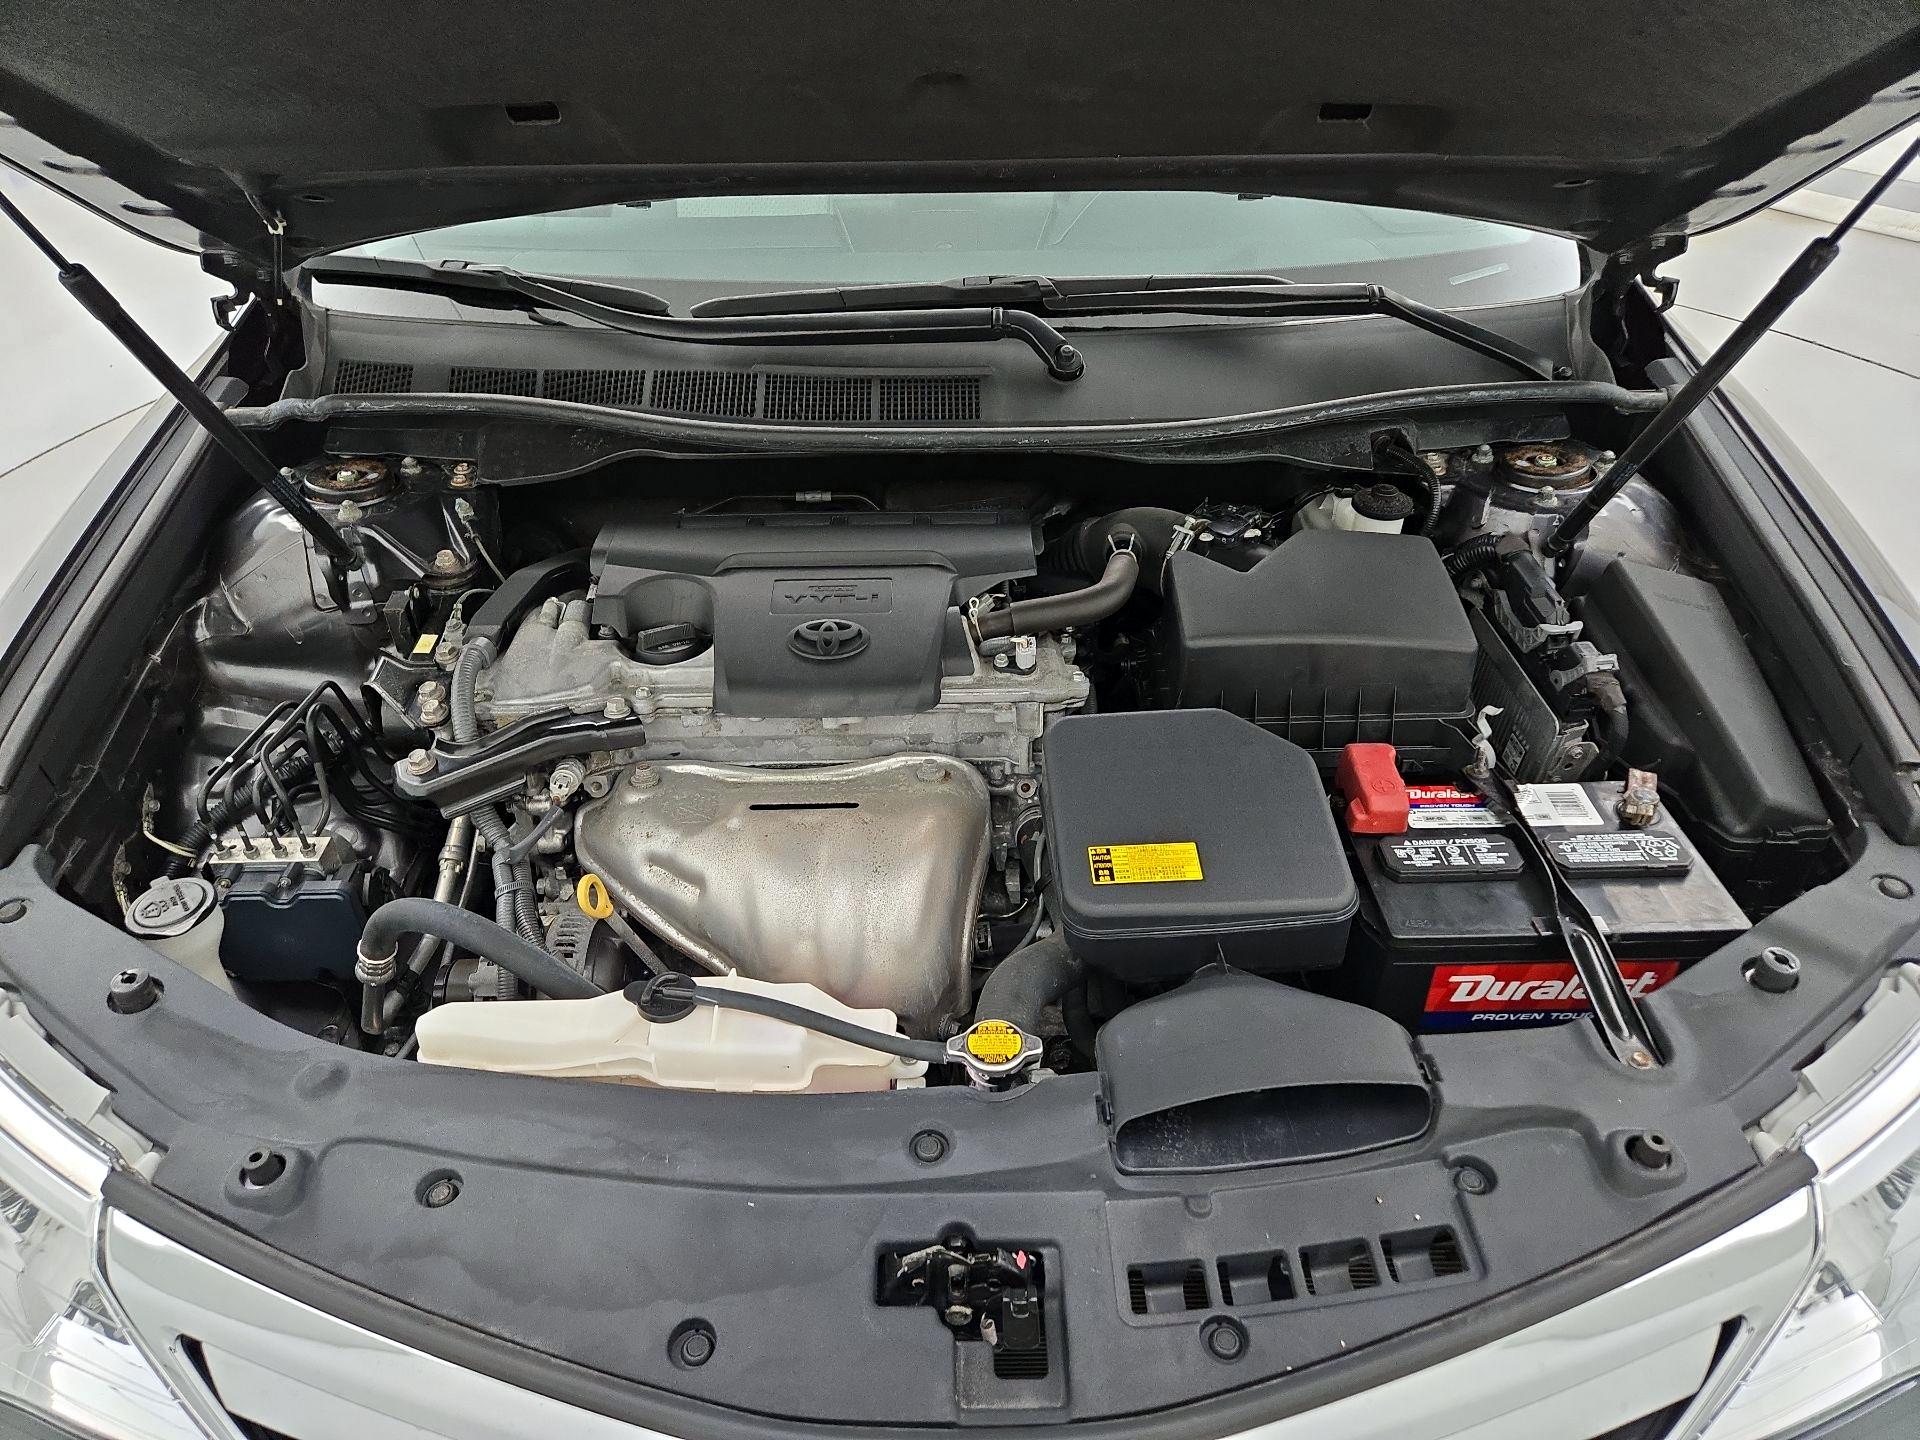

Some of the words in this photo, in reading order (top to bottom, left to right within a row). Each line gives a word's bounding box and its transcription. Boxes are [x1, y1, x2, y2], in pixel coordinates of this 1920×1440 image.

[1405, 788, 1477, 799] Duralas
[1471, 1012, 1545, 1022] PROVEN
[1551, 1012, 1595, 1021] TOUG
